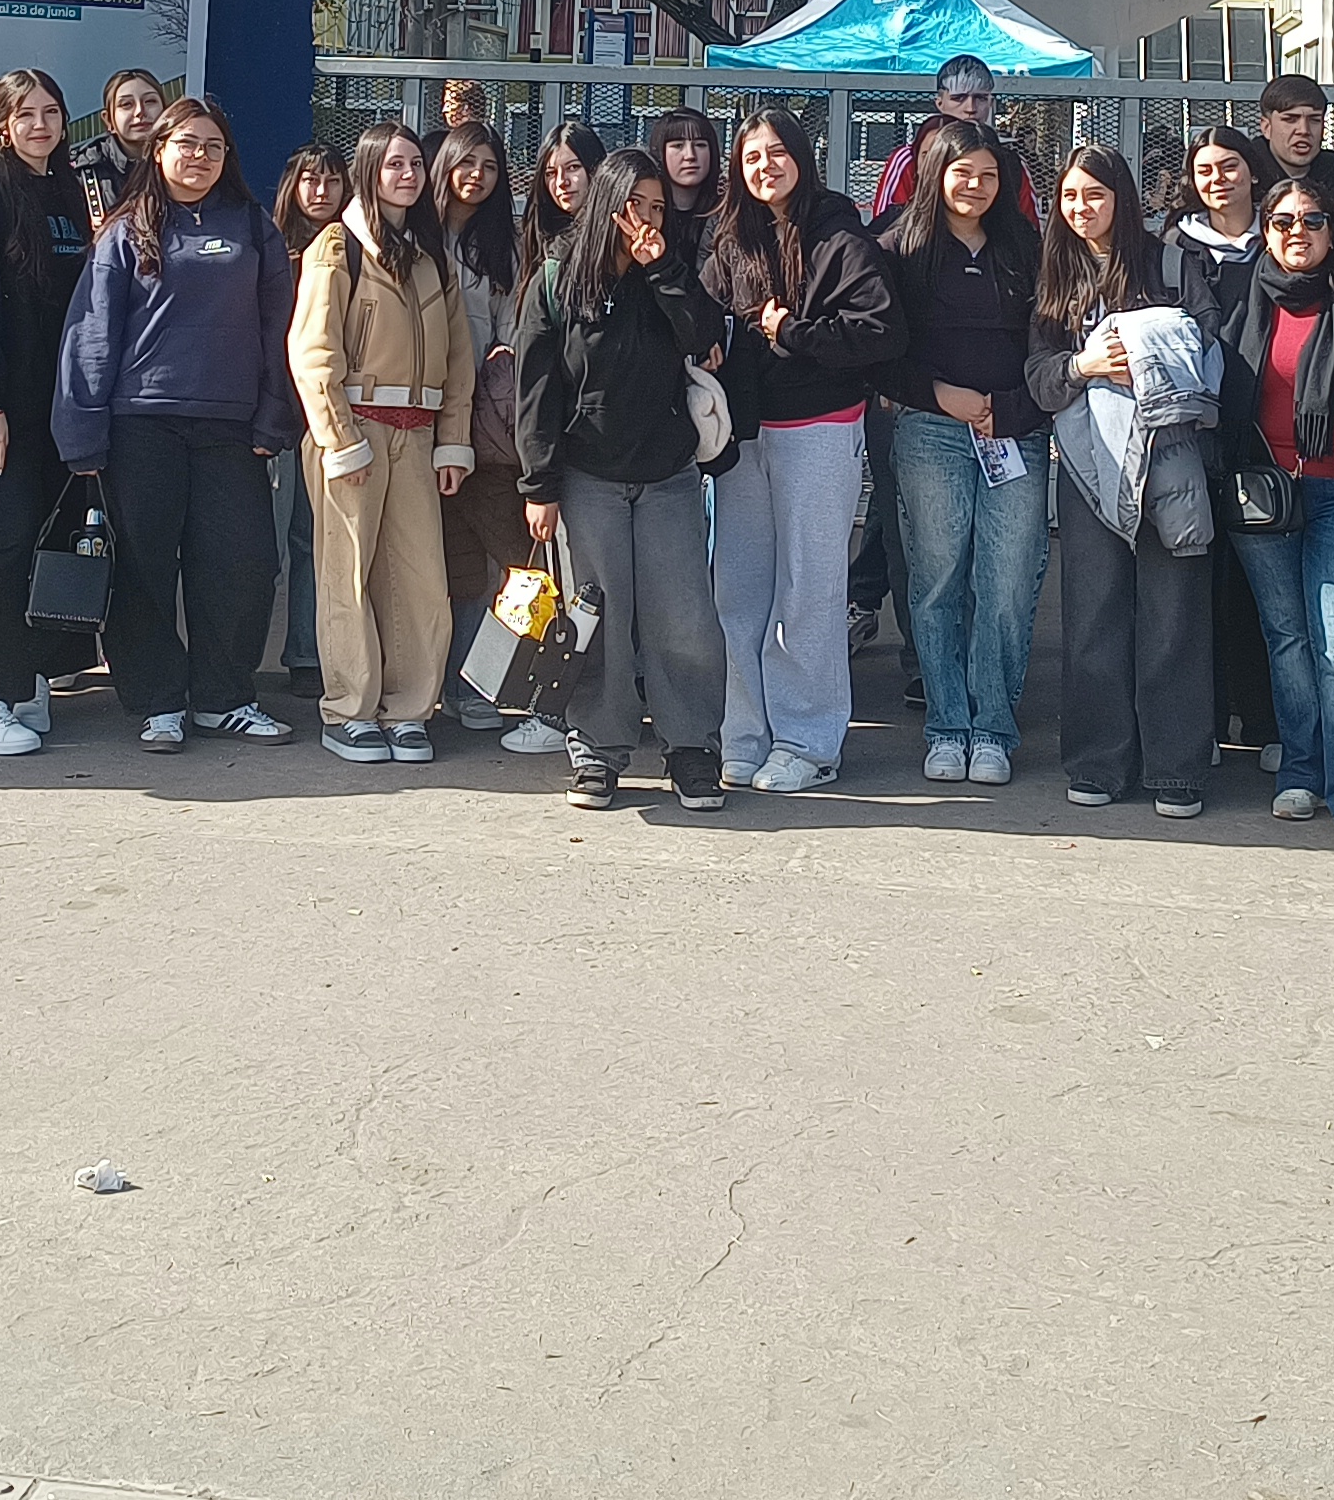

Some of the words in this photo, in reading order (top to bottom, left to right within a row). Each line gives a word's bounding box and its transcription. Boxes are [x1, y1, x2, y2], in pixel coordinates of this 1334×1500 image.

[11, 4, 28, 15] 28
[29, 5, 45, 16] de
[46, 6, 76, 19] junio
